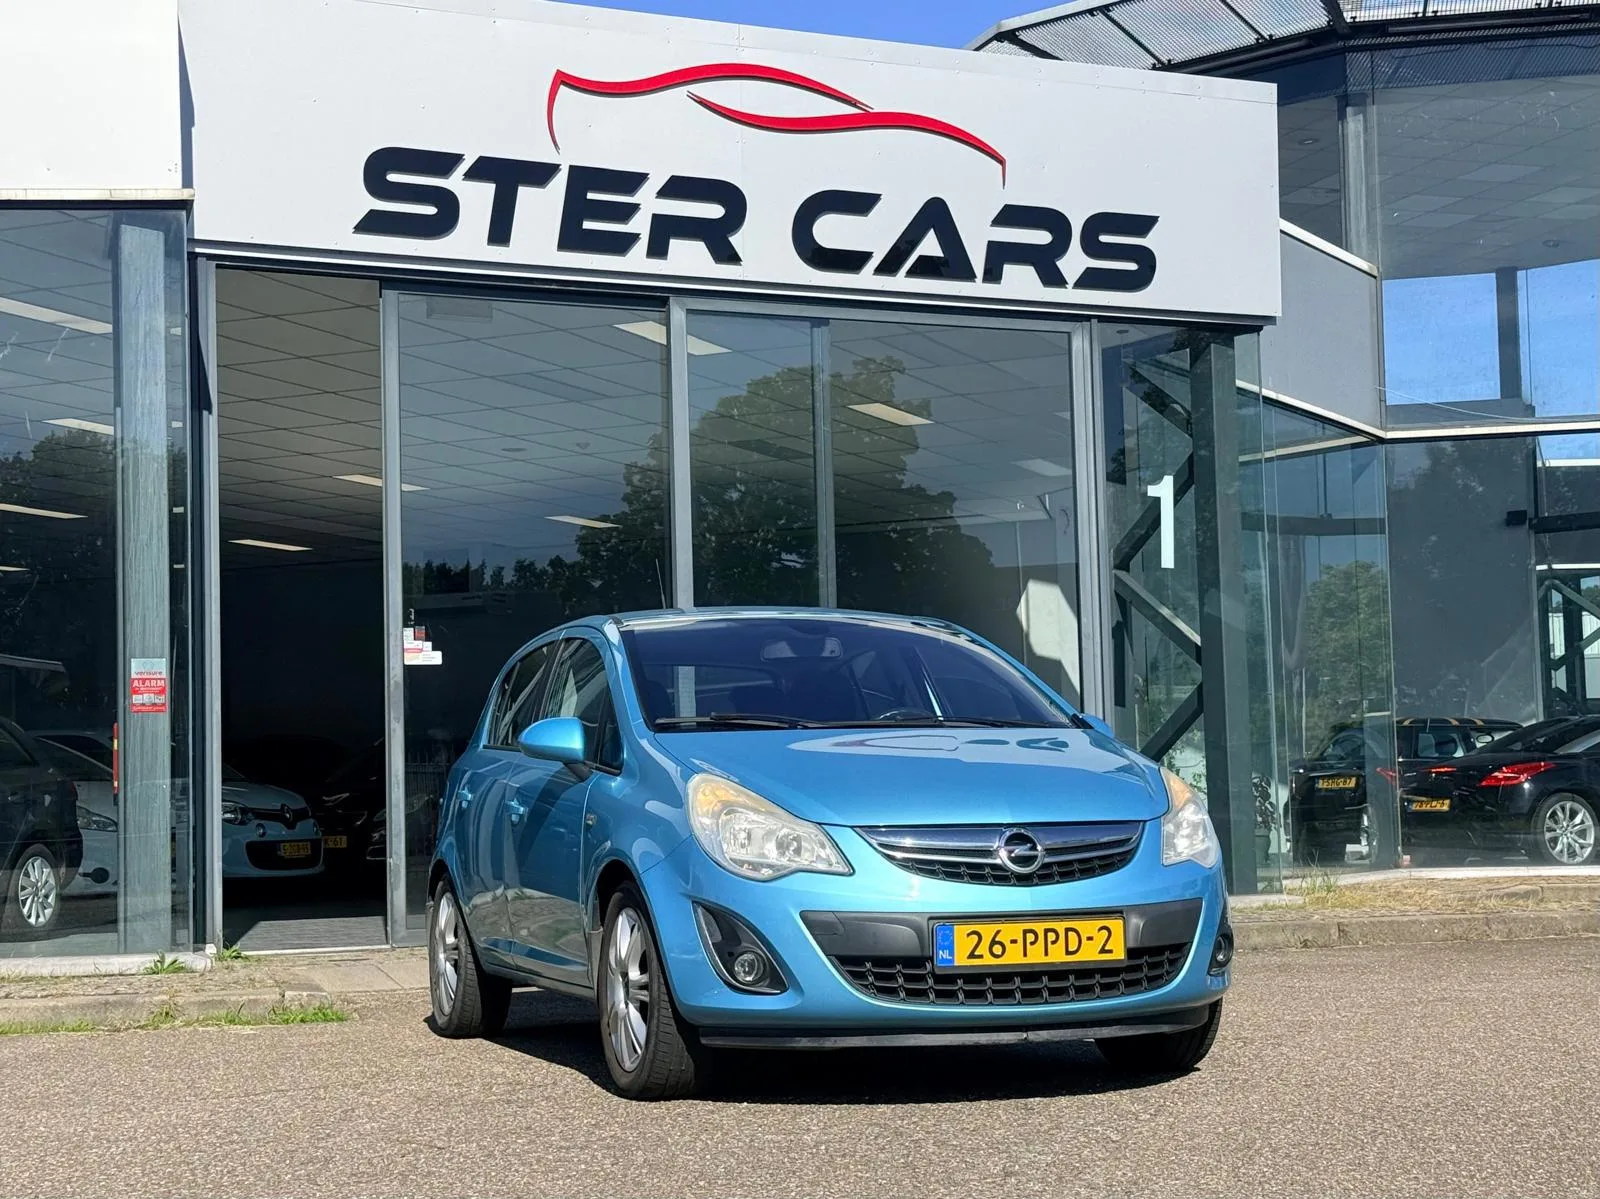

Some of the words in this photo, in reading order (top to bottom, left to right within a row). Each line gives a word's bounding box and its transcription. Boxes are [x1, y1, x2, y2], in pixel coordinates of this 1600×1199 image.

[353, 146, 748, 267] STER
[791, 189, 1160, 293] CARS
[1147, 475, 1174, 568] 1
[132, 679, 165, 687] ALARM
[938, 949, 953, 960] NL
[965, 925, 1114, 960] 26-PPD-2
